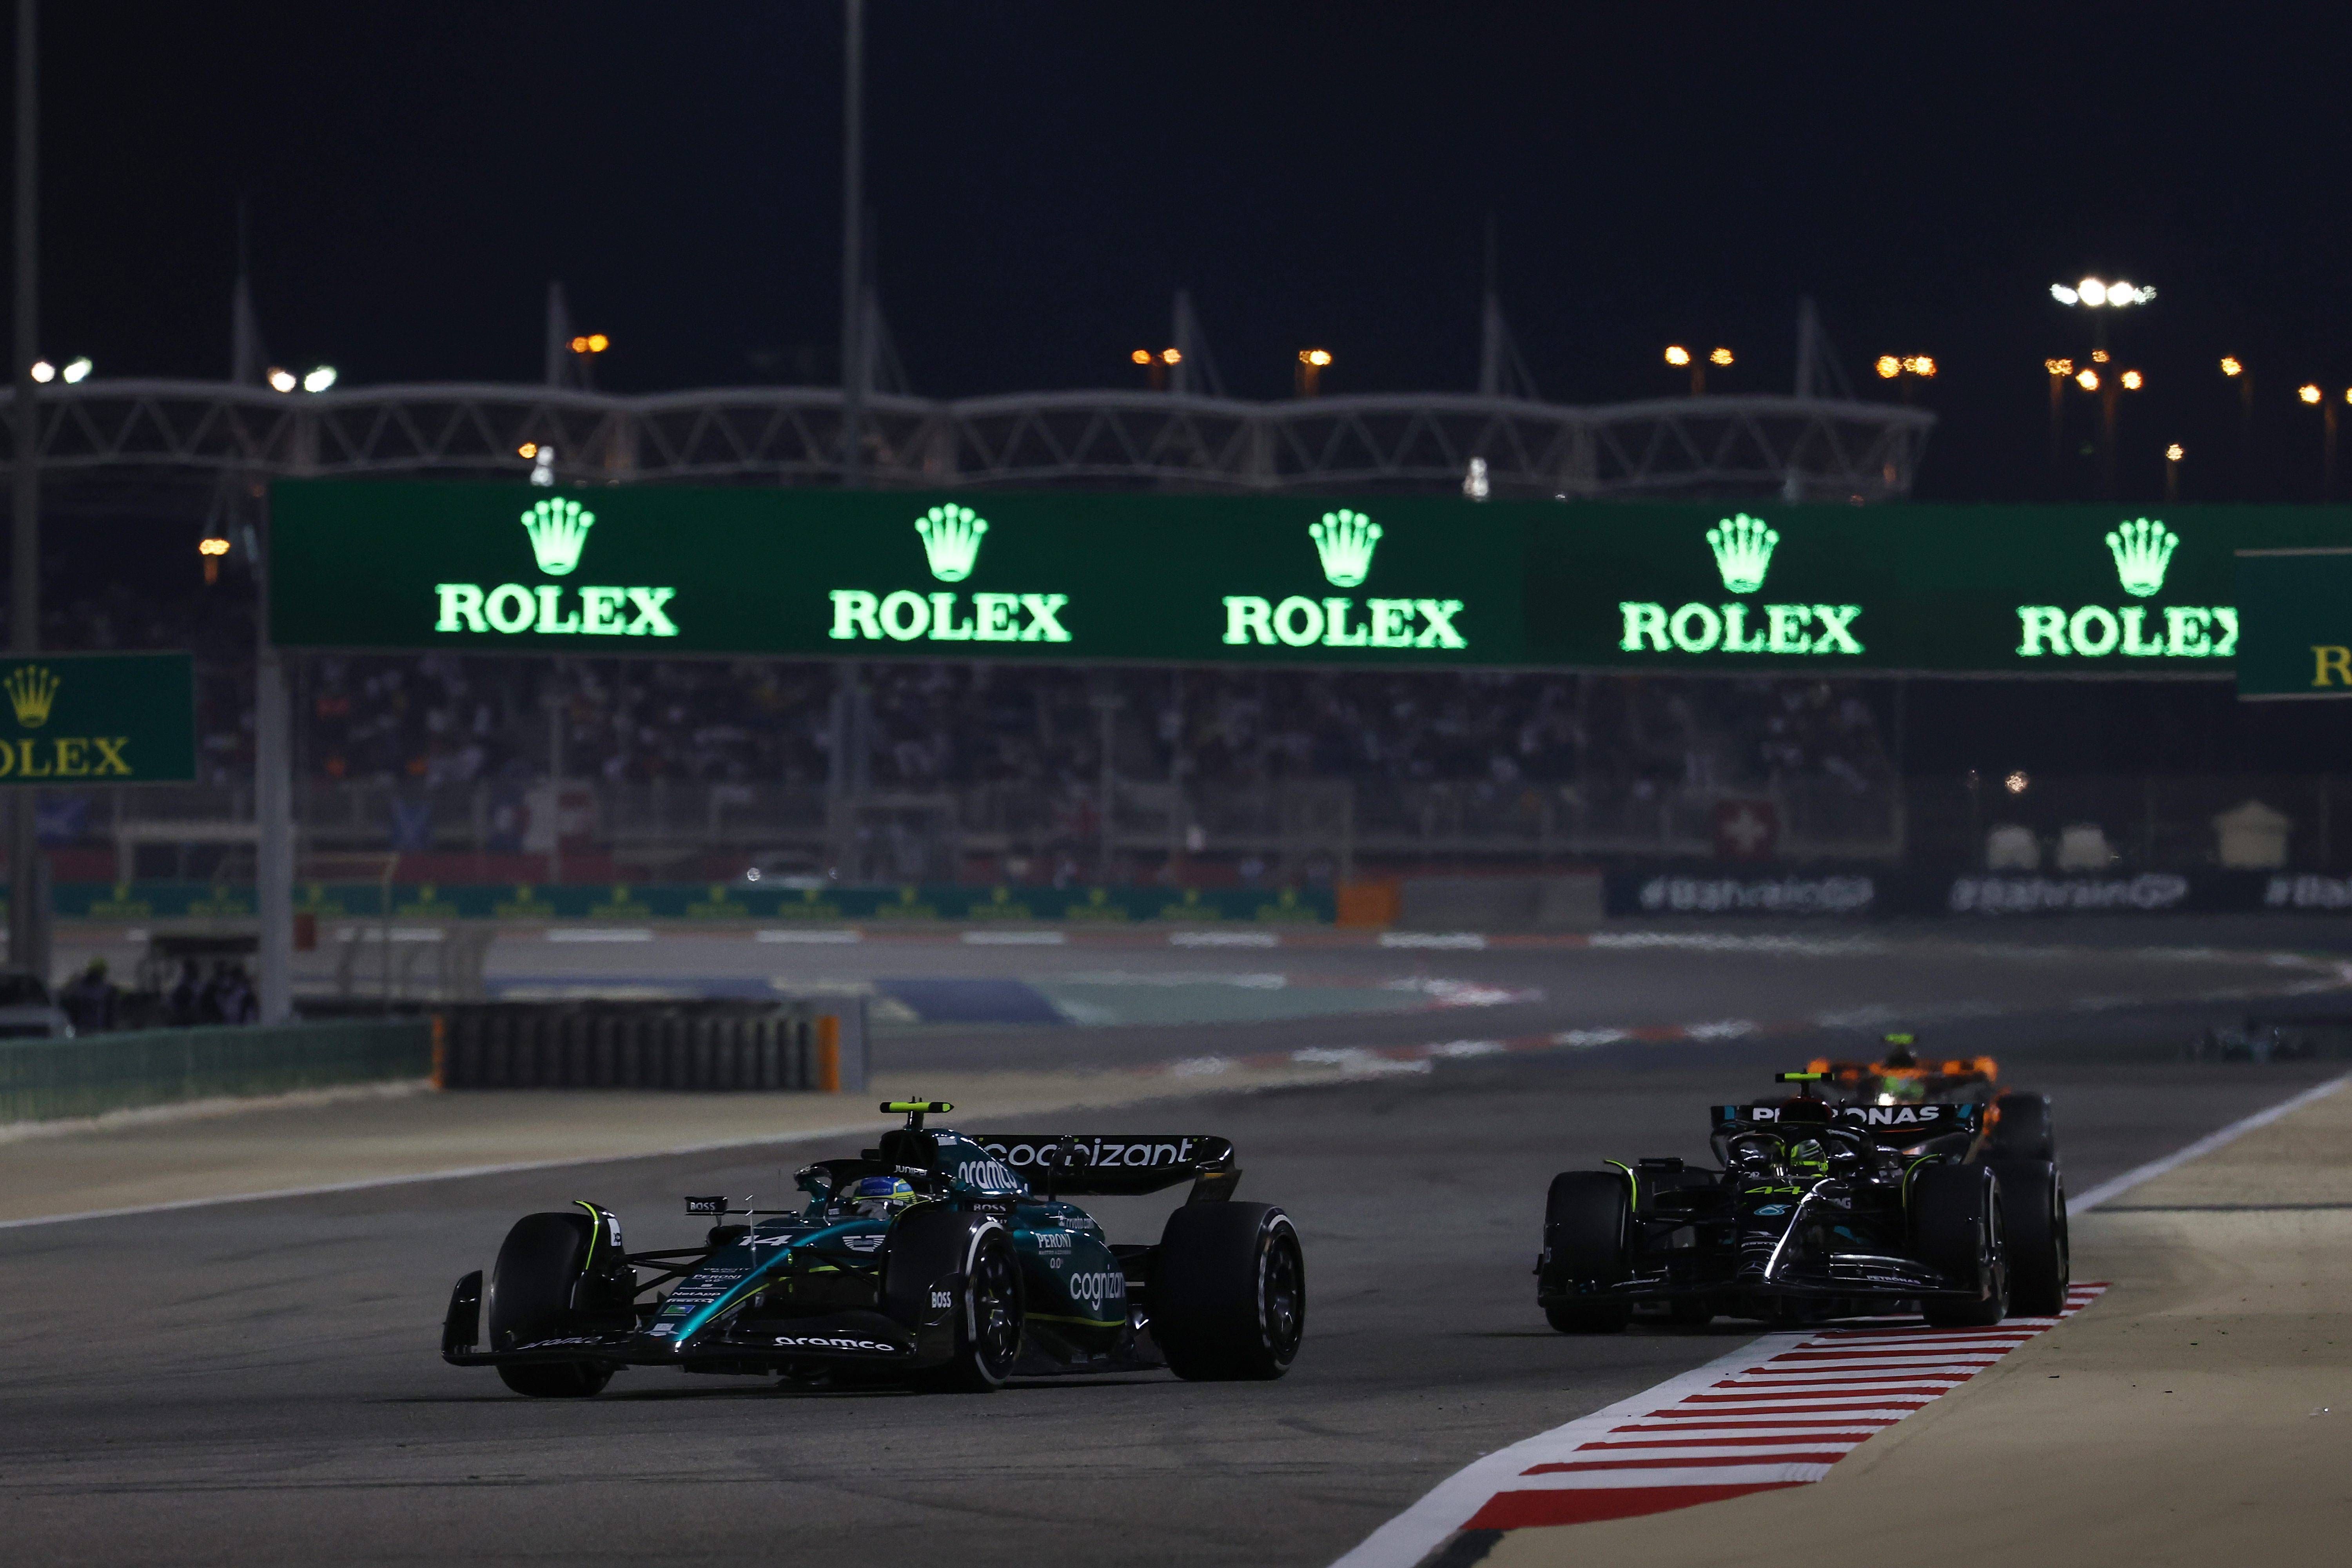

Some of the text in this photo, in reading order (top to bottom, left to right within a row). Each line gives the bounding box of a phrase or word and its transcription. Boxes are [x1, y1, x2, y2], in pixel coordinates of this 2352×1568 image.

[436, 584, 679, 637] ROLEX
[829, 590, 1073, 642] ROLEX
[1223, 595, 1468, 649] ROLEX
[1619, 602, 1865, 654] ROLEX
[1744, 1186, 1805, 1194] 44
[690, 1201, 716, 1210] BOSS
[973, 1203, 1006, 1212] BOSS
[738, 1235, 793, 1246] 14
[1035, 1233, 1072, 1248] PERONI
[931, 1291, 952, 1308] BOSS
[773, 1336, 895, 1351] aramco
